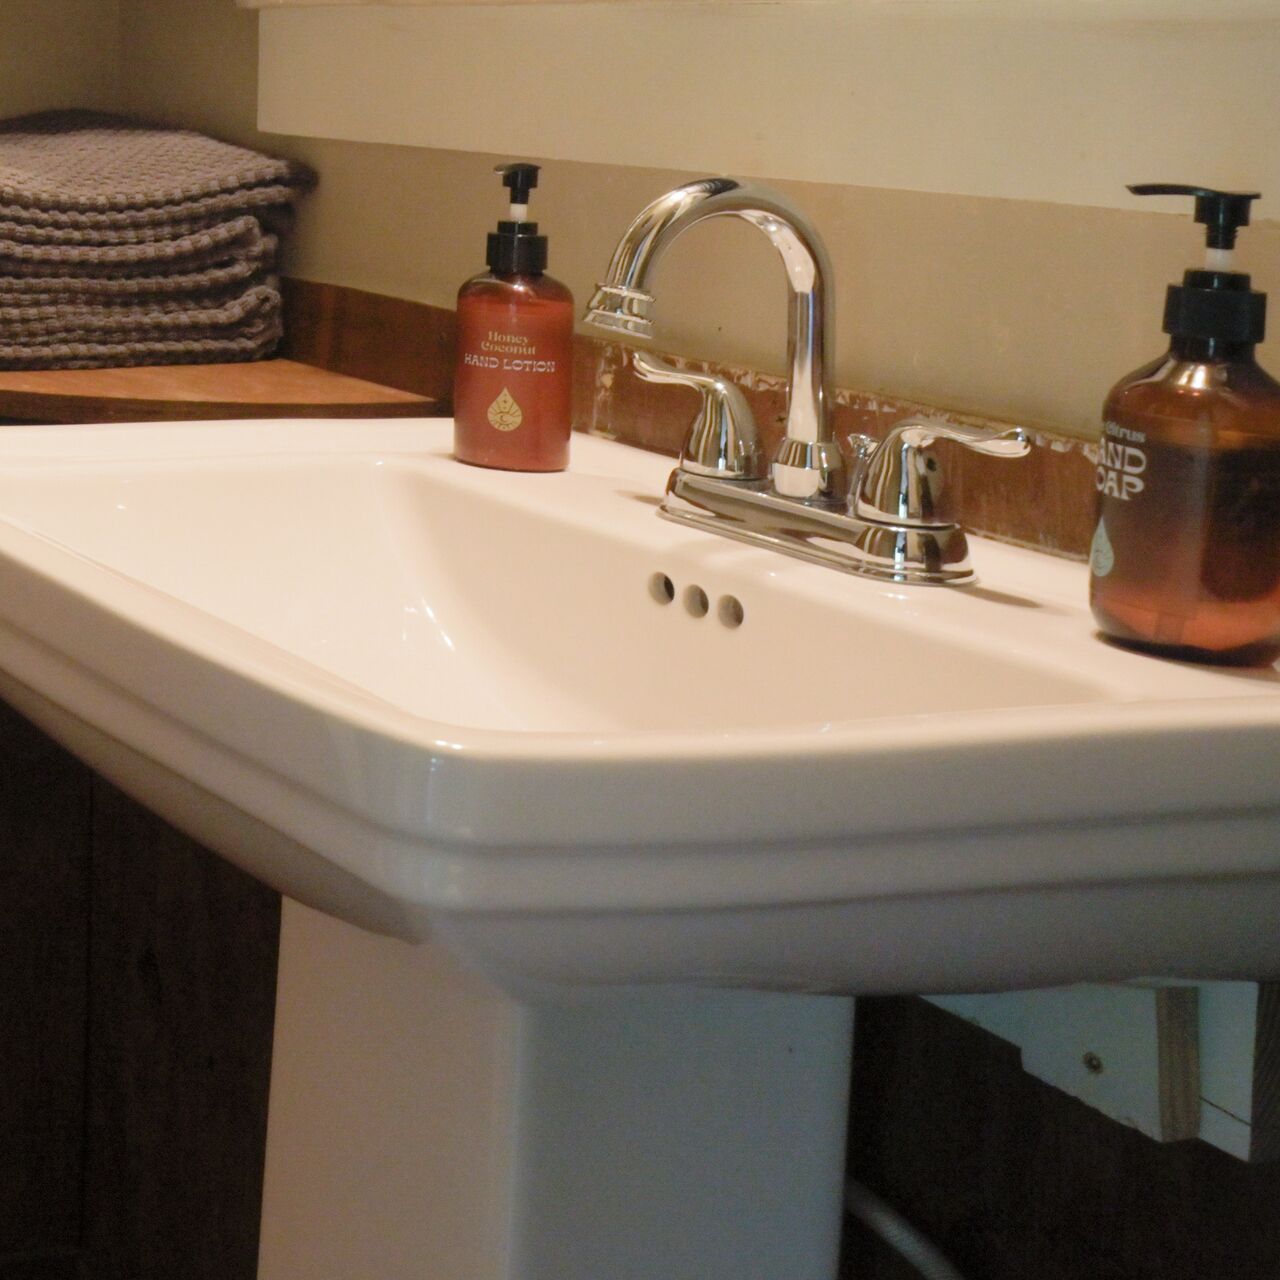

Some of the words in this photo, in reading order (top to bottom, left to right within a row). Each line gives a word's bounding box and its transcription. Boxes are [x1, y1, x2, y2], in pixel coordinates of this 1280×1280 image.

[488, 331, 529, 345] Honey
[481, 341, 537, 355] Coconut
[464, 353, 500, 368] HAND
[503, 359, 556, 372] LOTION
[1096, 437, 1147, 474] AND
[1096, 465, 1145, 500] OAP
